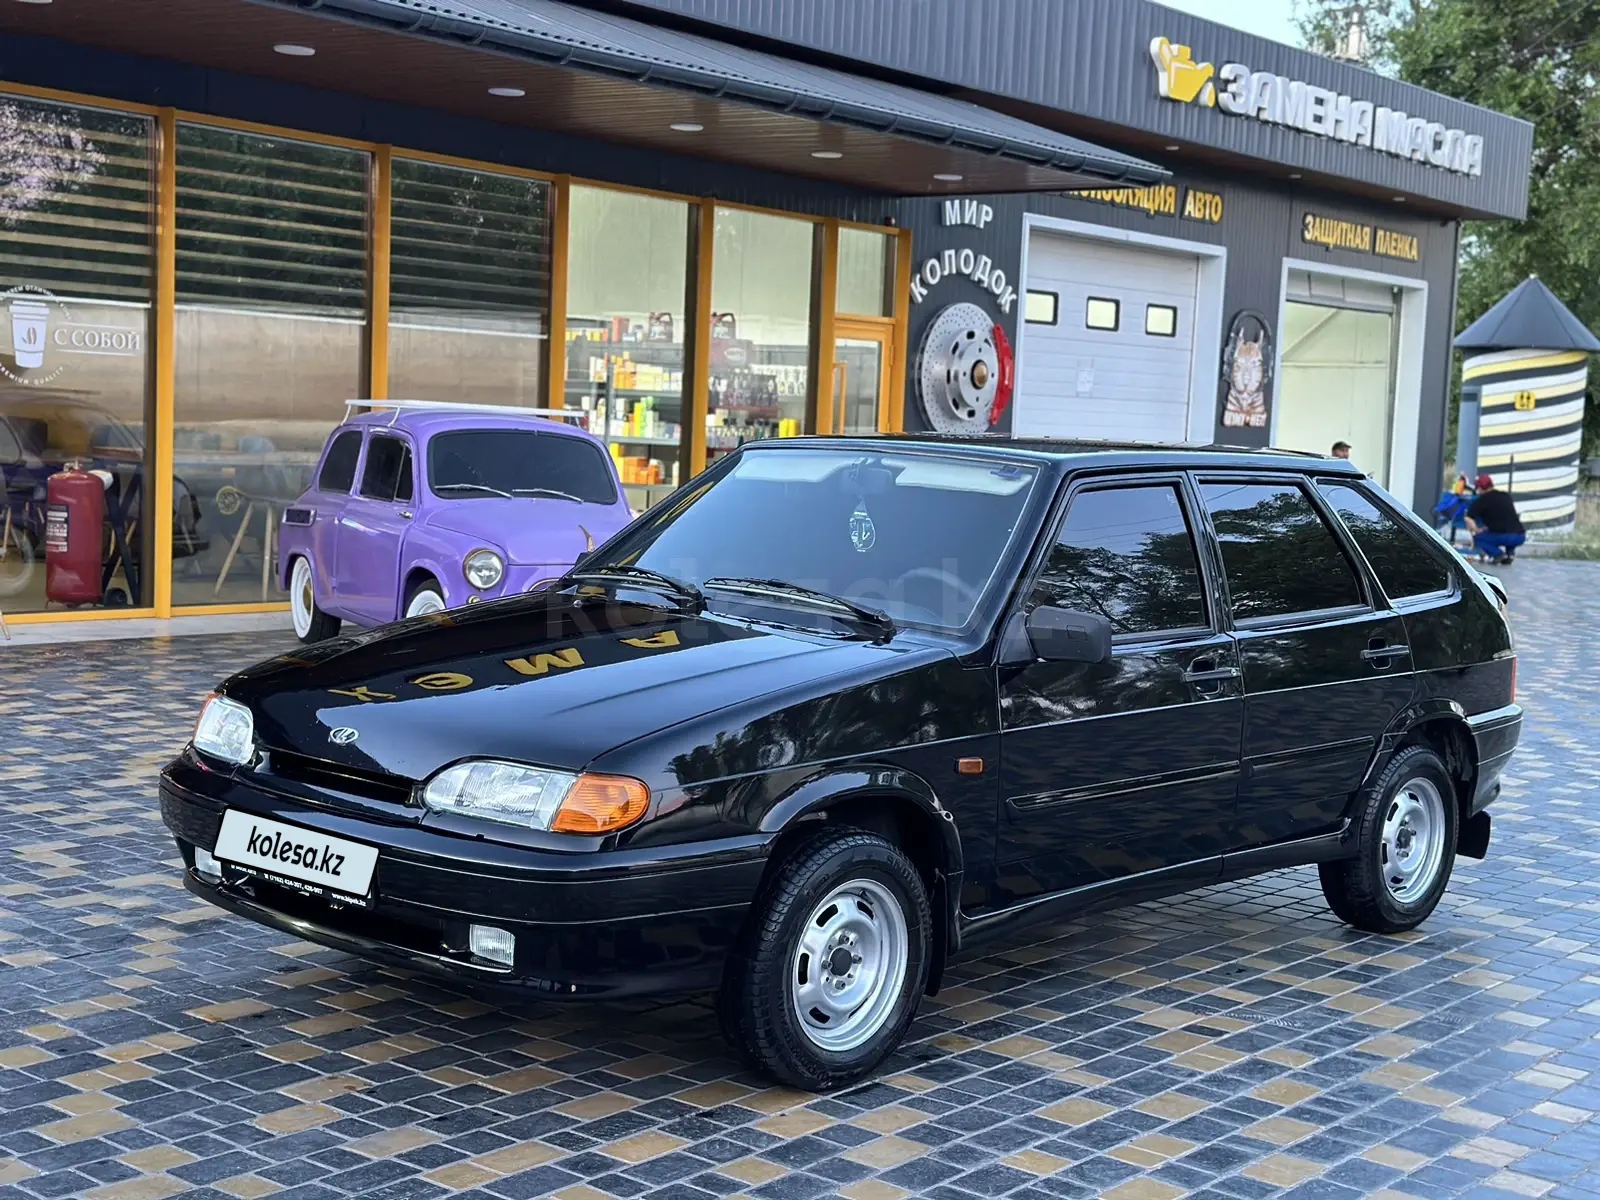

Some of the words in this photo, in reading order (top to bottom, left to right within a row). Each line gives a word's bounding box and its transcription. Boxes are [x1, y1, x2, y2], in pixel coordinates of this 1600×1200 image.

[1218, 63, 1374, 149] ЗАМЕНА
[1373, 107, 1484, 177] МАСЛА
[944, 199, 993, 229] МИР
[1184, 189, 1223, 223] АВТО
[1304, 214, 1371, 250] ЗАЩИТНАЯ
[1375, 228, 1418, 261] ПЛЕНКА
[910, 248, 1017, 314] КОЛОДОК
[54, 328, 68, 346] С
[71, 330, 141, 350] СОБОЙ
